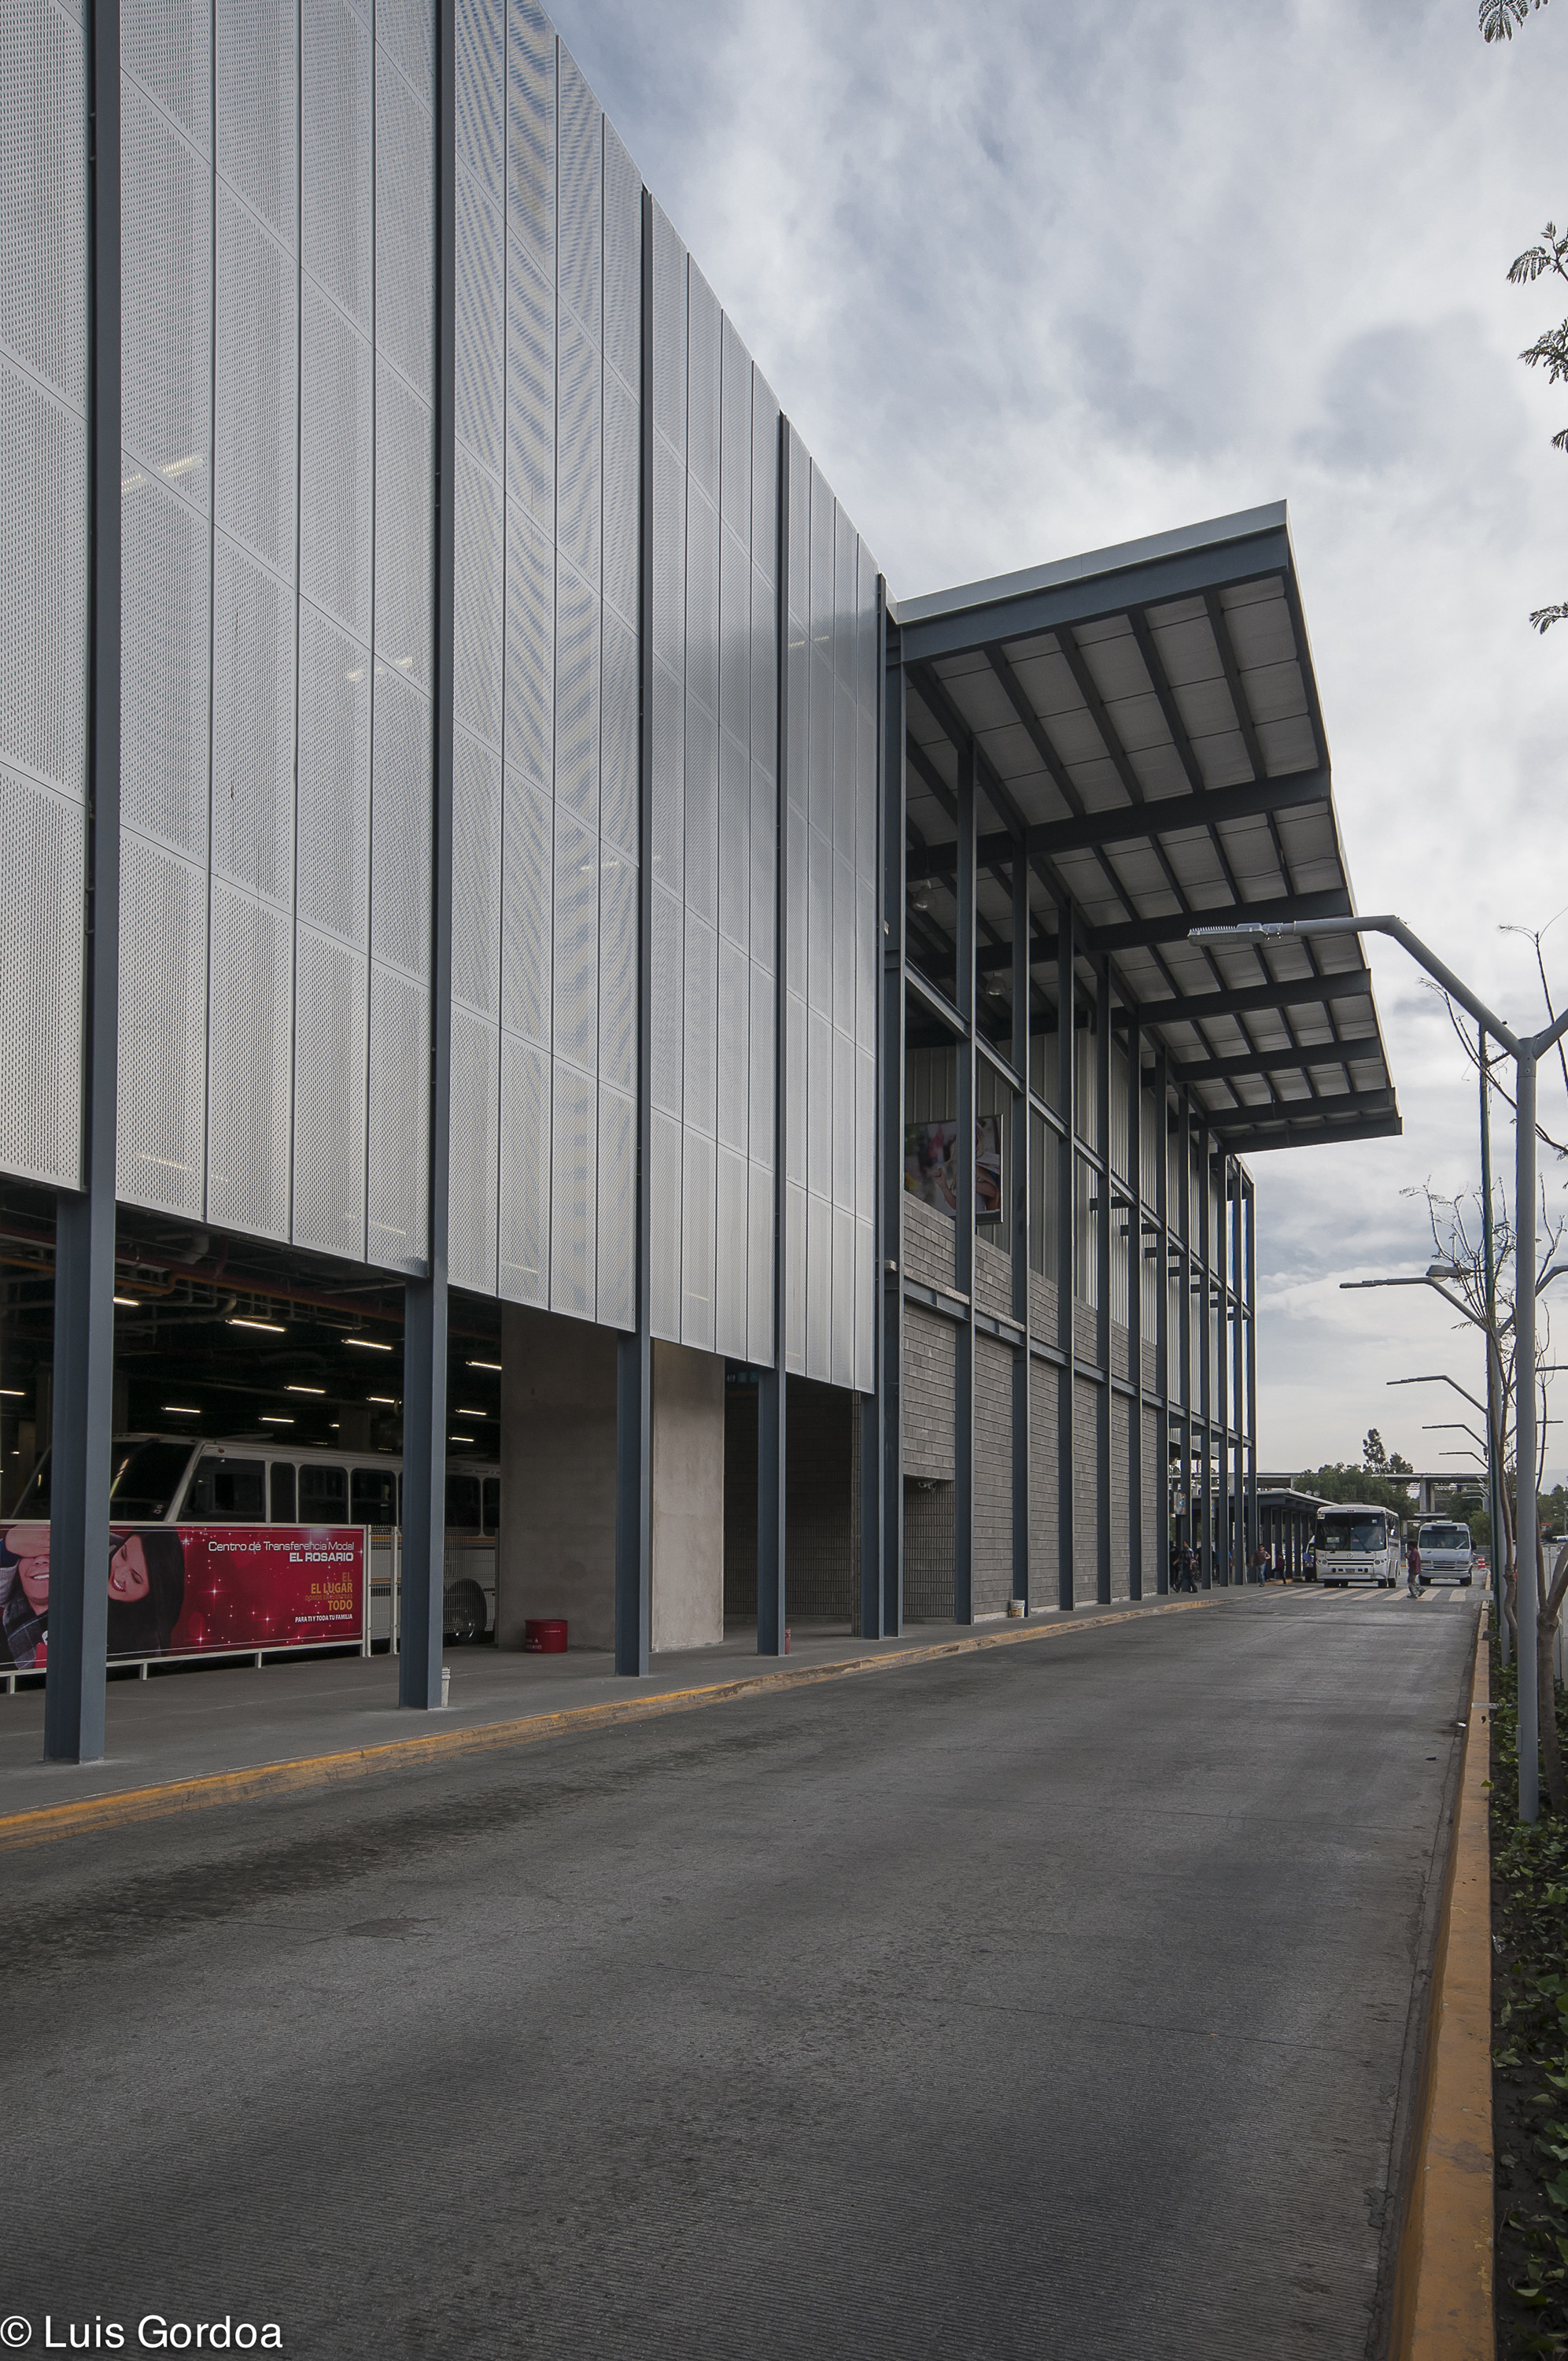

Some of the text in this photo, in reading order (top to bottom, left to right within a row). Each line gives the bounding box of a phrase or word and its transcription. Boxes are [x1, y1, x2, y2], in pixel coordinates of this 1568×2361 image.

[208, 1541, 247, 1552] Centro
[263, 1541, 327, 1551] Transferencia
[328, 1541, 354, 1551] Modal
[289, 1552, 354, 1562] EL ROSARIO
[342, 1572, 352, 1582] EL
[311, 1582, 352, 1594] EL LUGAR
[328, 1600, 353, 1611] TODO
